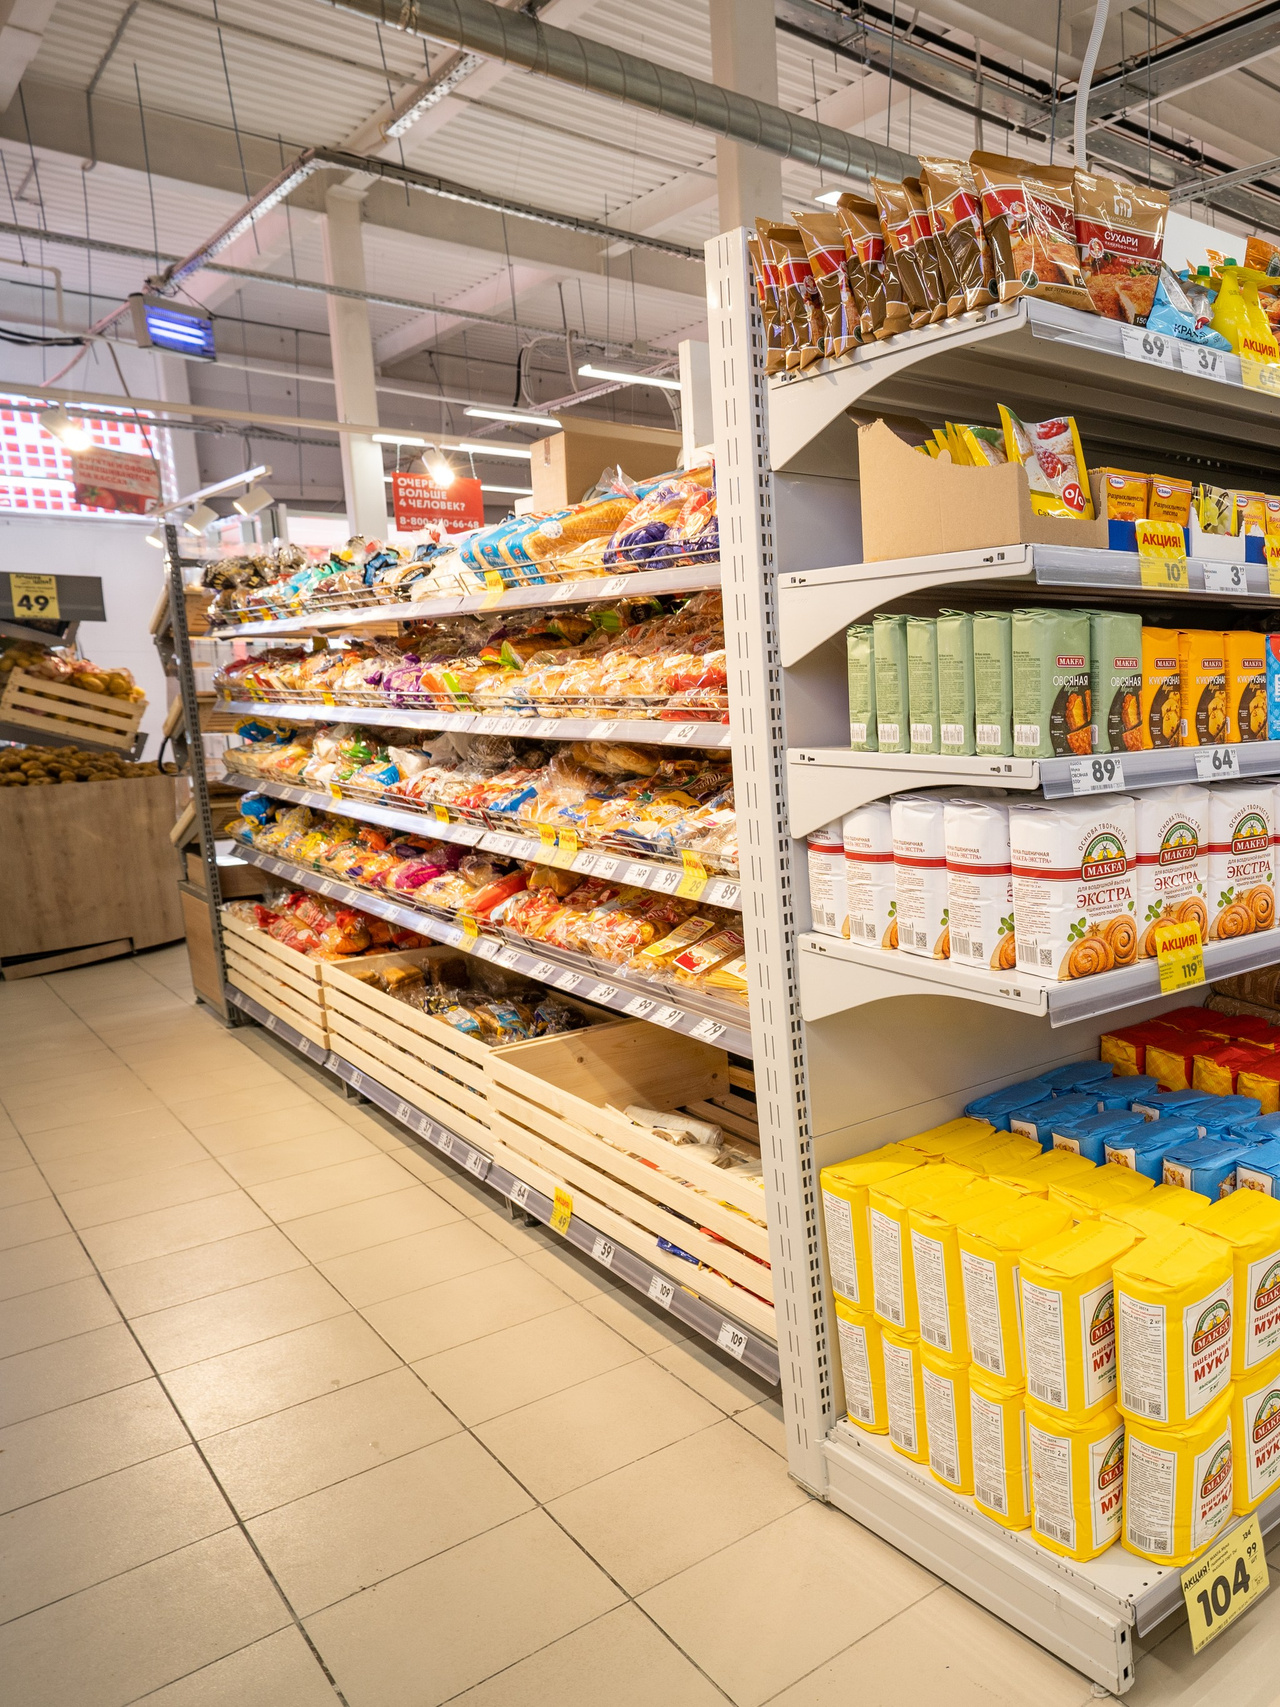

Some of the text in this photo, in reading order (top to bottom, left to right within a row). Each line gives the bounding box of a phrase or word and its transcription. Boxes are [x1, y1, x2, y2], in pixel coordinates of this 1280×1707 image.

[1104, 230, 1139, 247] СУХАРИ
[1142, 333, 1164, 358] 69
[1243, 337, 1277, 358] АКЦИЯ!
[1198, 347, 1217, 372] 37
[397, 477, 446, 490] ОЧЕРЕД
[398, 487, 448, 500] БОЛЬШЕ
[1107, 492, 1145, 503] Разрыхлитель
[398, 498, 466, 512] 4 ЧЕЛОВЕК?
[1116, 500, 1136, 508] теста
[1153, 501, 1187, 512] Разрыхлитель
[1162, 510, 1178, 518] теста
[1142, 533, 1181, 548] АКЦИЯ!
[1164, 562, 1181, 582] 10
[1230, 565, 1241, 586] 3
[17, 594, 50, 612] 49
[1058, 656, 1084, 666] MAKFA
[1115, 659, 1137, 667] MAKFA
[1156, 659, 1176, 667] MAKFA
[1203, 660, 1222, 668] MAKFA
[1052, 675, 1089, 687] ОВСЯНАЯ
[1110, 676, 1142, 687] ОВСЯНАЯ
[677, 725, 689, 739] 62
[1212, 748, 1233, 770] 64
[1091, 759, 1116, 782] 89
[1229, 803, 1271, 828] ОСНОВА ТВОРЧЕСТВА
[1157, 813, 1202, 838] ОСНОВА ТВОРЧЕСТВА
[1077, 823, 1128, 851] ОСНОВА ТВОРЧЕСТВА
[1235, 836, 1267, 850] MAKFA
[579, 855, 594, 868] 39
[1163, 847, 1196, 863] MAKFA
[635, 867, 648, 879] 149
[1086, 860, 1124, 877] MAKFA
[1226, 859, 1271, 879] ЭКСТРА
[663, 872, 677, 887] 99
[688, 880, 701, 893] 29
[1086, 881, 1113, 891] ВОЗДУШНОЙ
[1113, 877, 1131, 888] ВЫПЕЧКИ
[1153, 869, 1200, 891] ЭКСТРА
[721, 884, 737, 899] 89
[1076, 885, 1132, 909] ЭКСТРА
[1161, 933, 1198, 953] АКЦИЯ!
[1181, 963, 1198, 979] 119
[600, 986, 615, 998] 39
[635, 999, 652, 1011] 99
[667, 1009, 682, 1020] 91
[704, 1021, 723, 1036] 79
[472, 1156, 482, 1168] 41
[516, 1185, 527, 1199] 64
[557, 1215, 568, 1228] 49
[600, 1242, 612, 1259] 59
[659, 1283, 671, 1297] 109
[1121, 1309, 1133, 1319] МАССА
[730, 1331, 744, 1348] 109
[1194, 1314, 1231, 1352] MAKFA
[1192, 1336, 1231, 1369] ПШЕНИЧНАЯ
[1193, 1349, 1230, 1383] МУКА
[1246, 1541, 1257, 1558] 99
[1183, 1560, 1211, 1593] АКЦИЯ!
[1196, 1556, 1251, 1627] 104
